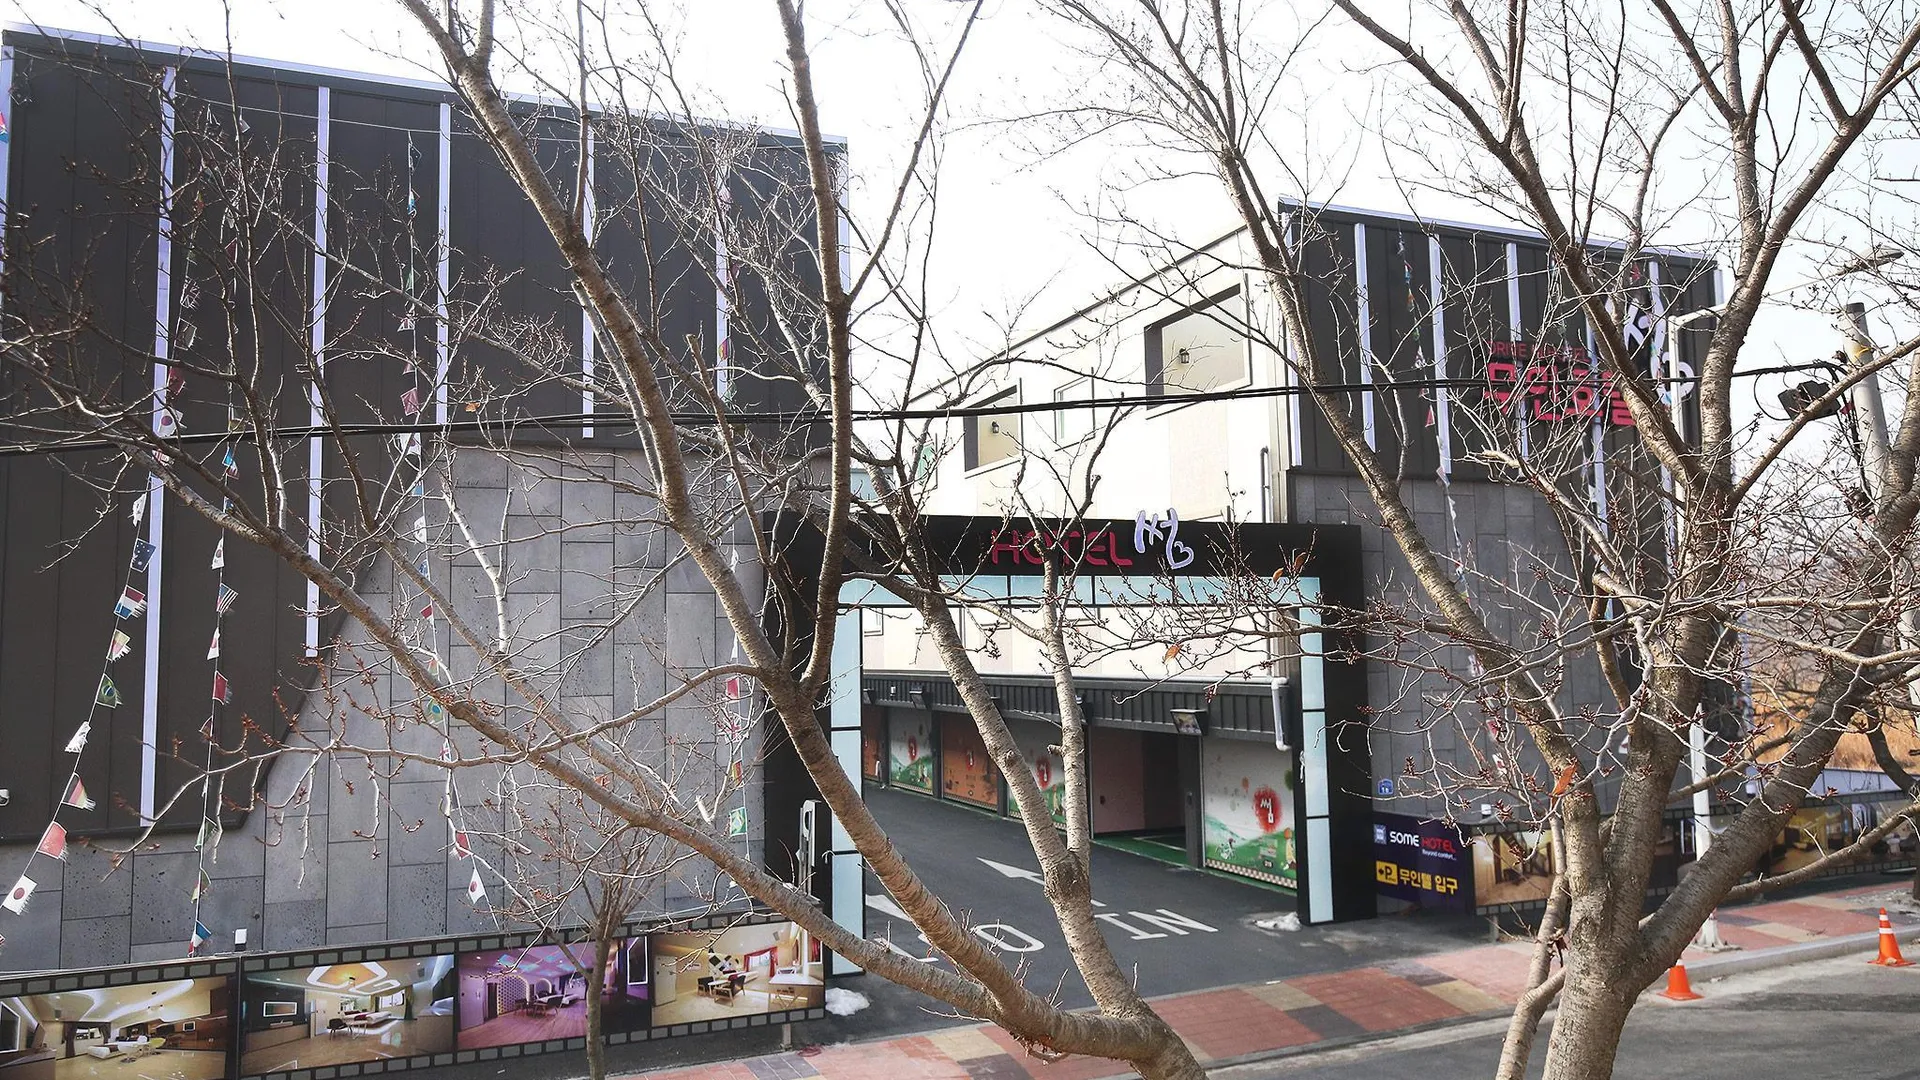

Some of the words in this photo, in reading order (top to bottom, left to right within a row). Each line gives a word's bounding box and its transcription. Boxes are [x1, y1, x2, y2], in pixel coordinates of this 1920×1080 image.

[990, 529, 1133, 566] HOTEL
[1389, 830, 1420, 847] SOME
[1421, 836, 1456, 853] HOTEL
[1434, 875, 1458, 895] 입구
[1094, 909, 1218, 940] IN
